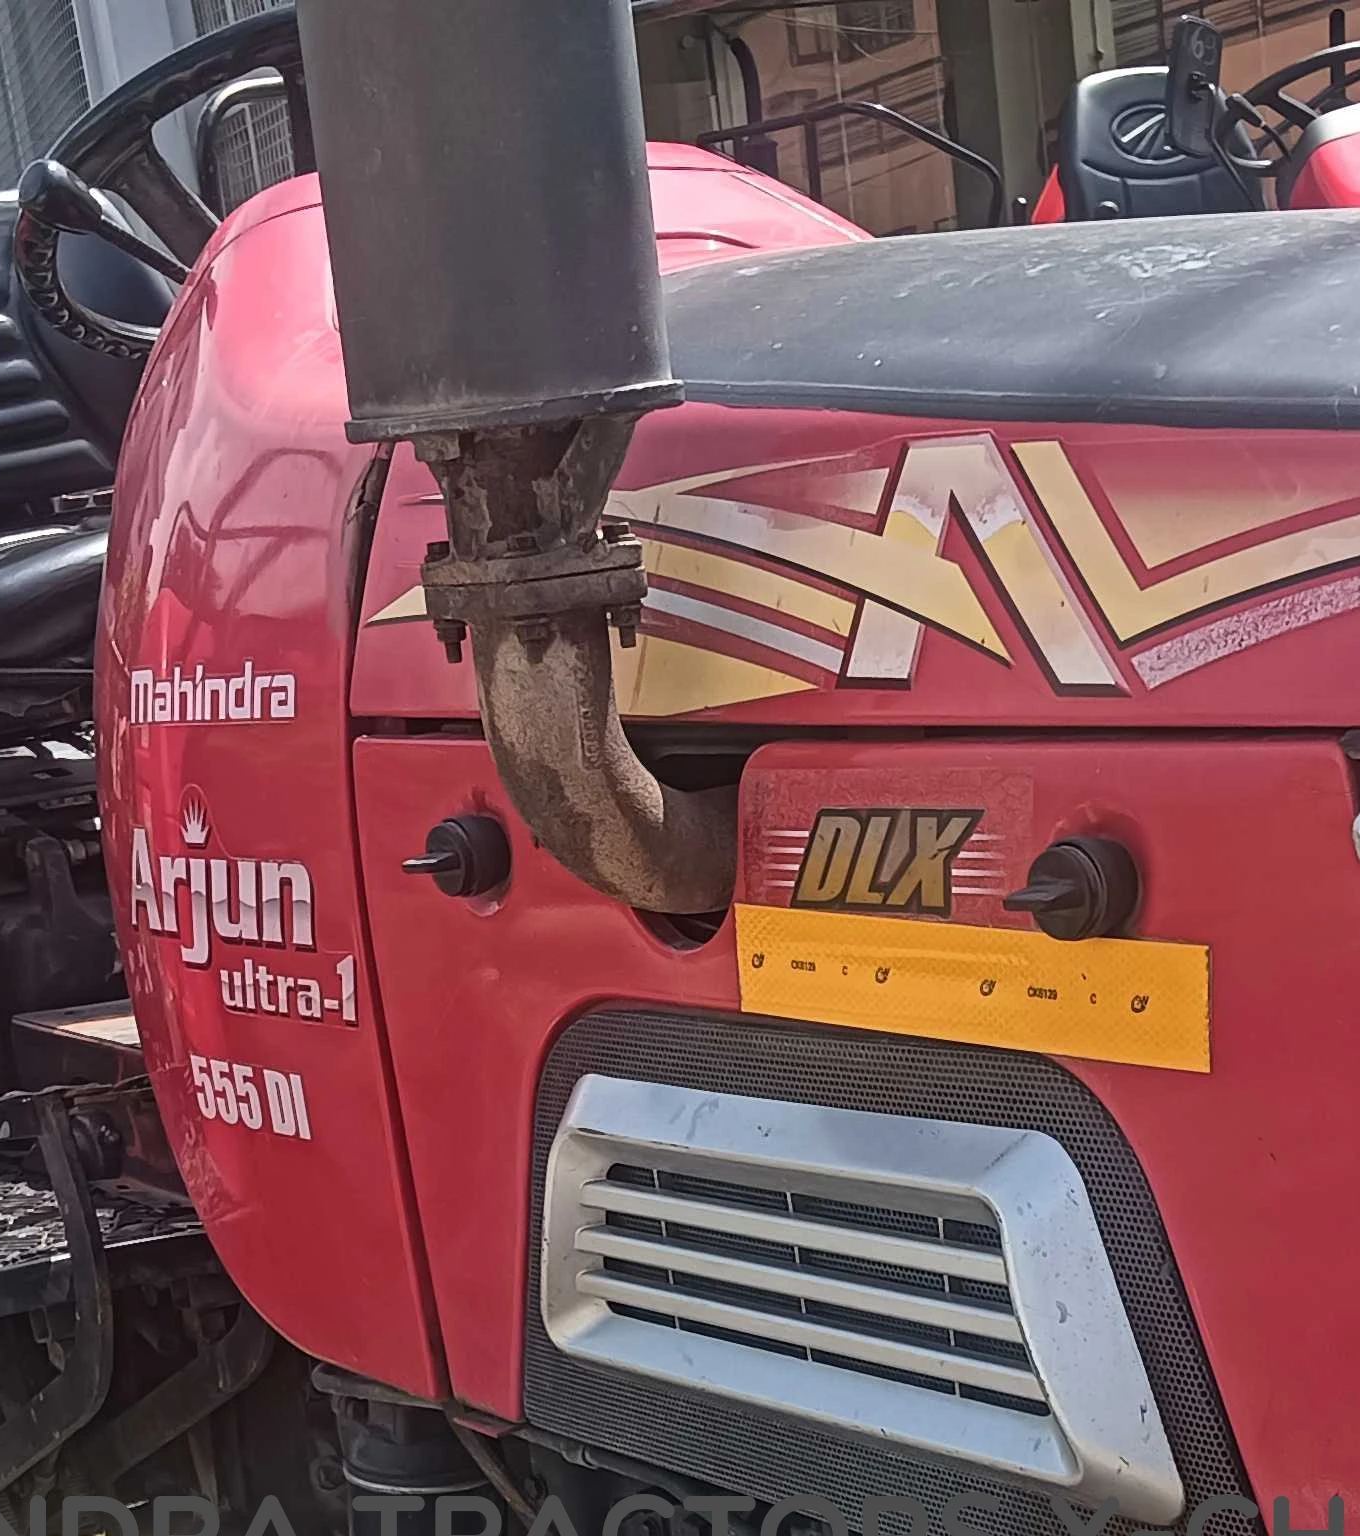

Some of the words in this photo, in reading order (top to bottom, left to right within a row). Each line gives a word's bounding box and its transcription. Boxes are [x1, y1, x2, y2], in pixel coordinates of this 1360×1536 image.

[130, 661, 296, 723] Mahindra
[130, 827, 316, 966] Arjun
[794, 811, 979, 913] DLX
[220, 954, 357, 1022] ultra-1
[190, 1053, 263, 1131] 555
[264, 1070, 312, 1141] DI
